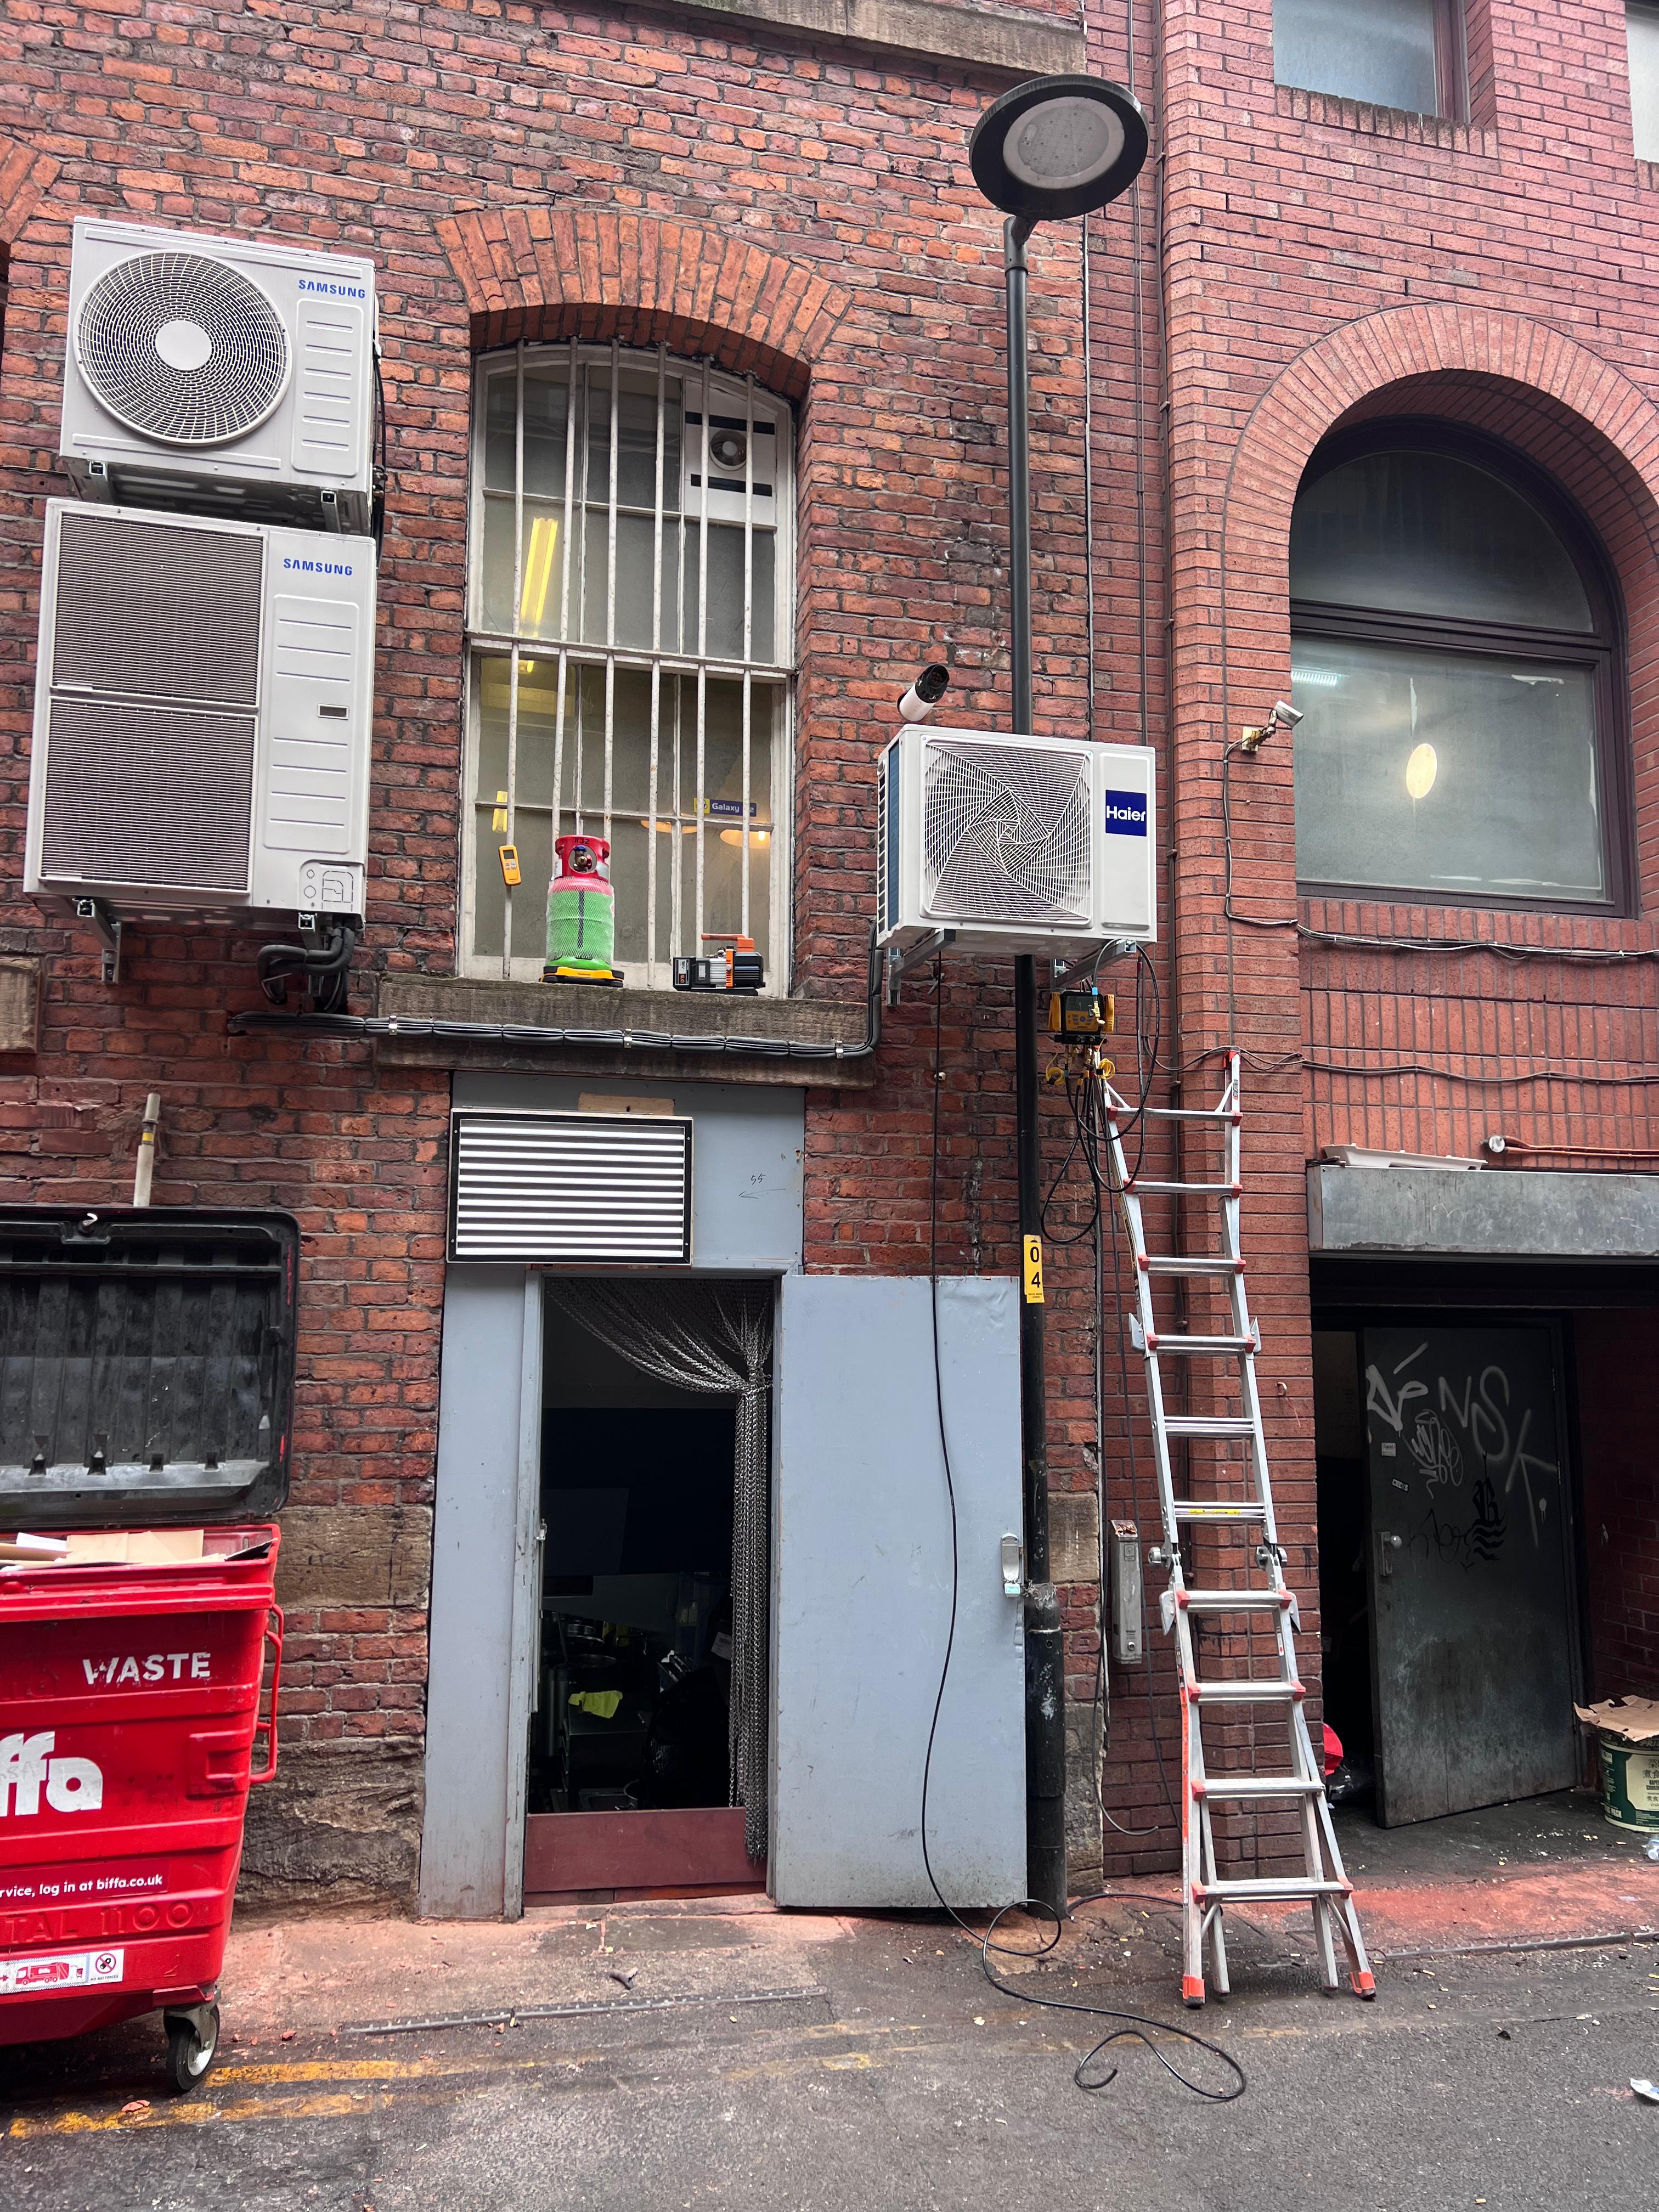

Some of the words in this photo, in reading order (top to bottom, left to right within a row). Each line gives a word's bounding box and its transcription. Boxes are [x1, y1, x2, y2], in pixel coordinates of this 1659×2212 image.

[298, 279, 365, 298] SAMSUNG
[283, 558, 352, 576] SAMSUNG
[712, 803, 740, 813] Galaxy
[1106, 805, 1146, 822] Haier
[82, 1651, 211, 1685] WASTE
[40, 1884, 60, 1896] log
[64, 1881, 76, 1892] in
[79, 1881, 93, 1891] at
[97, 1874, 163, 1889] biffa.co.uk
